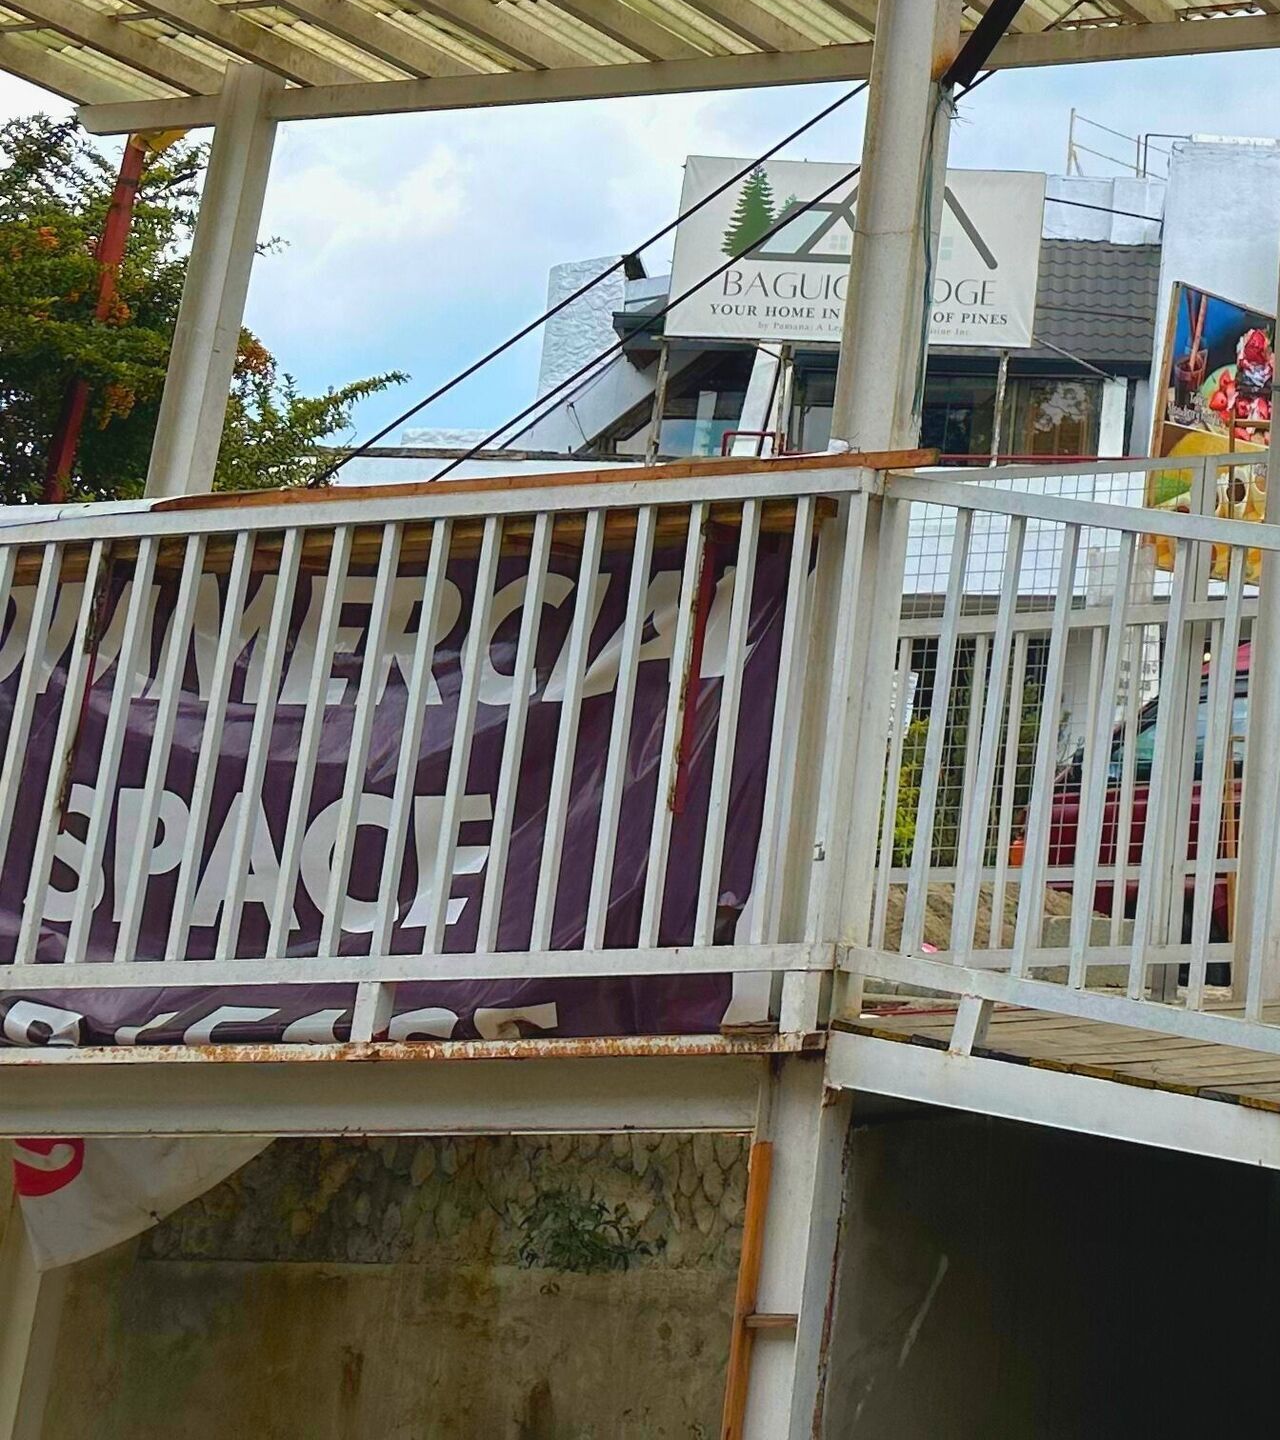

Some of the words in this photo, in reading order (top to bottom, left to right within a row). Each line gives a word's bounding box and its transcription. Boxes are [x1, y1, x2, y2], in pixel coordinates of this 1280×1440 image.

[710, 303, 758, 317] YOUR
[764, 306, 816, 320] HOME
[822, 308, 840, 320] IN
[933, 311, 954, 324] OF
[961, 312, 1008, 326] PINES
[26, 783, 493, 935] SPACE
